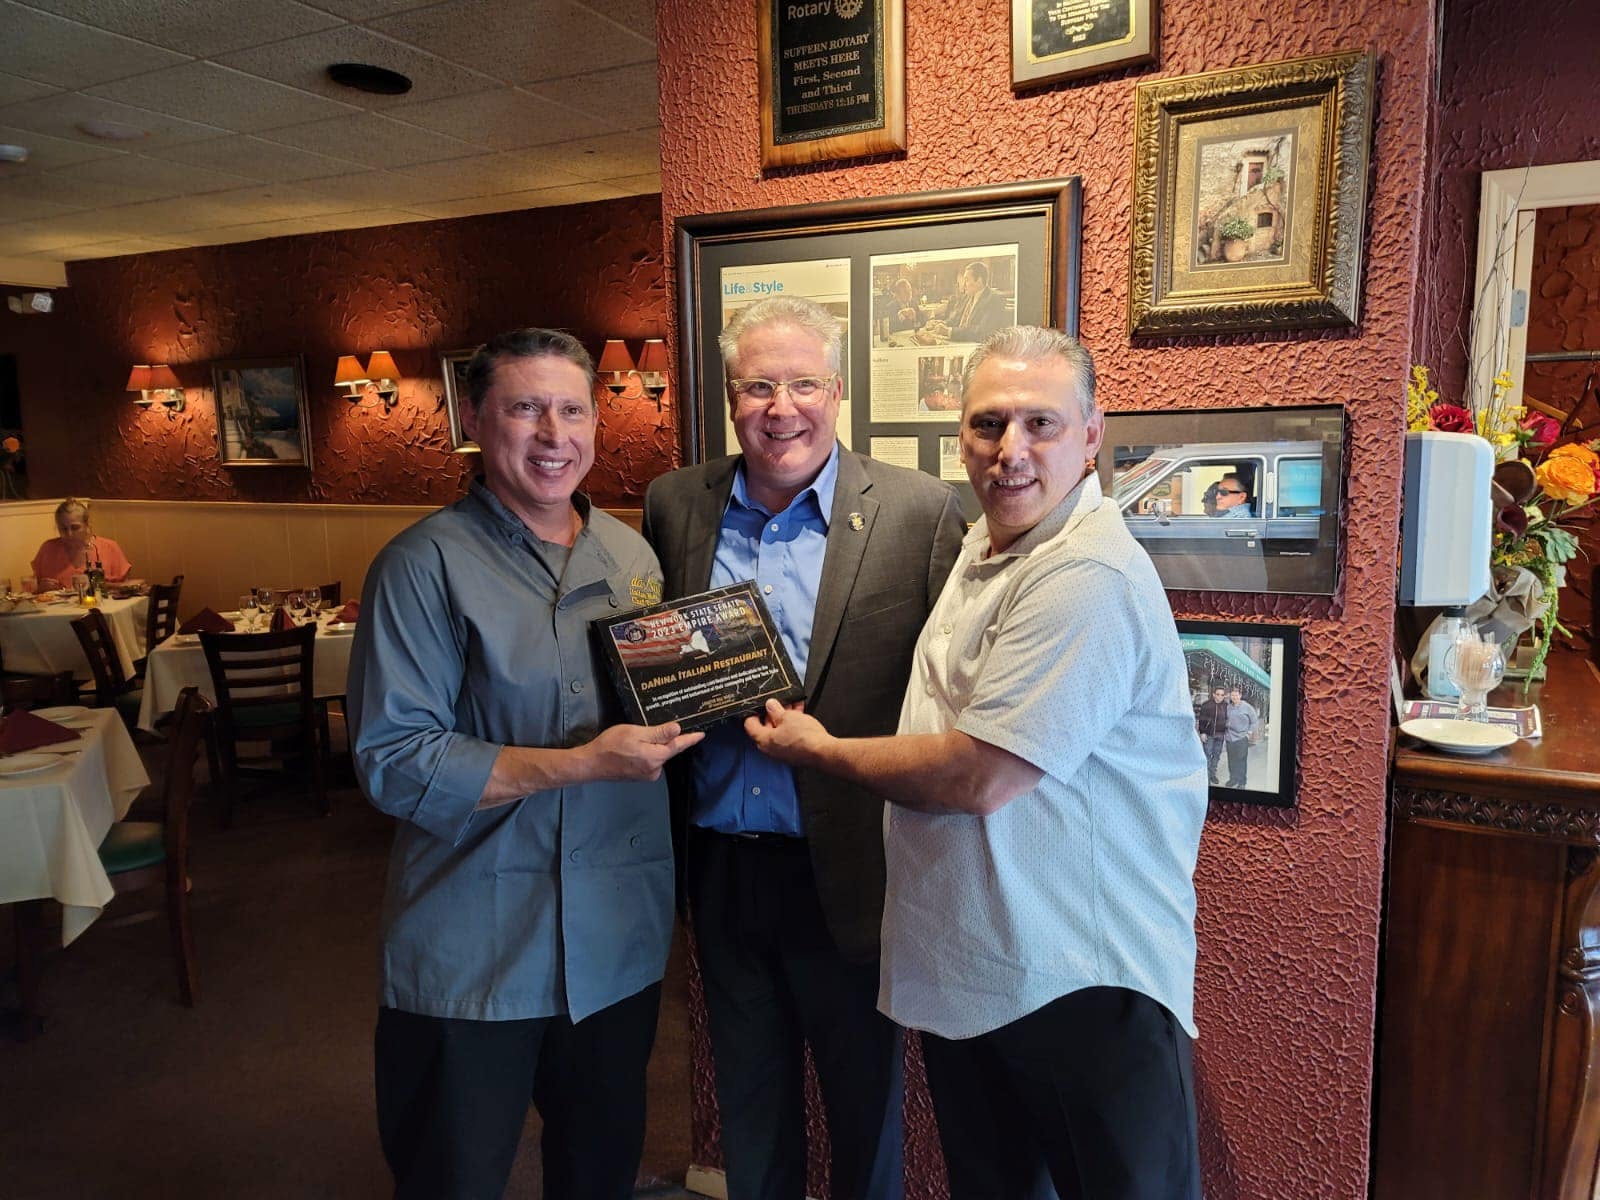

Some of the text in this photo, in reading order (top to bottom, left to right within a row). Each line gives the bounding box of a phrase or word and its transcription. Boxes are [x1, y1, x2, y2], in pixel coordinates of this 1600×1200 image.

[788, 1, 832, 20] Rotary
[784, 33, 870, 59] SUFFERN ROTARY
[794, 50, 860, 72] MEETS HERE
[793, 66, 860, 86] First, Second
[801, 82, 852, 99] and Third
[786, 100, 834, 116] THURSDAYS
[856, 93, 870, 104] PM
[724, 282, 745, 295] Life
[753, 280, 784, 294] Style
[670, 612, 689, 623] YORK
[690, 606, 713, 618] STATE
[714, 599, 740, 612] SENATE
[652, 607, 746, 639] 2023 EMPIRE AWARD
[713, 648, 768, 670] RESTAURANT
